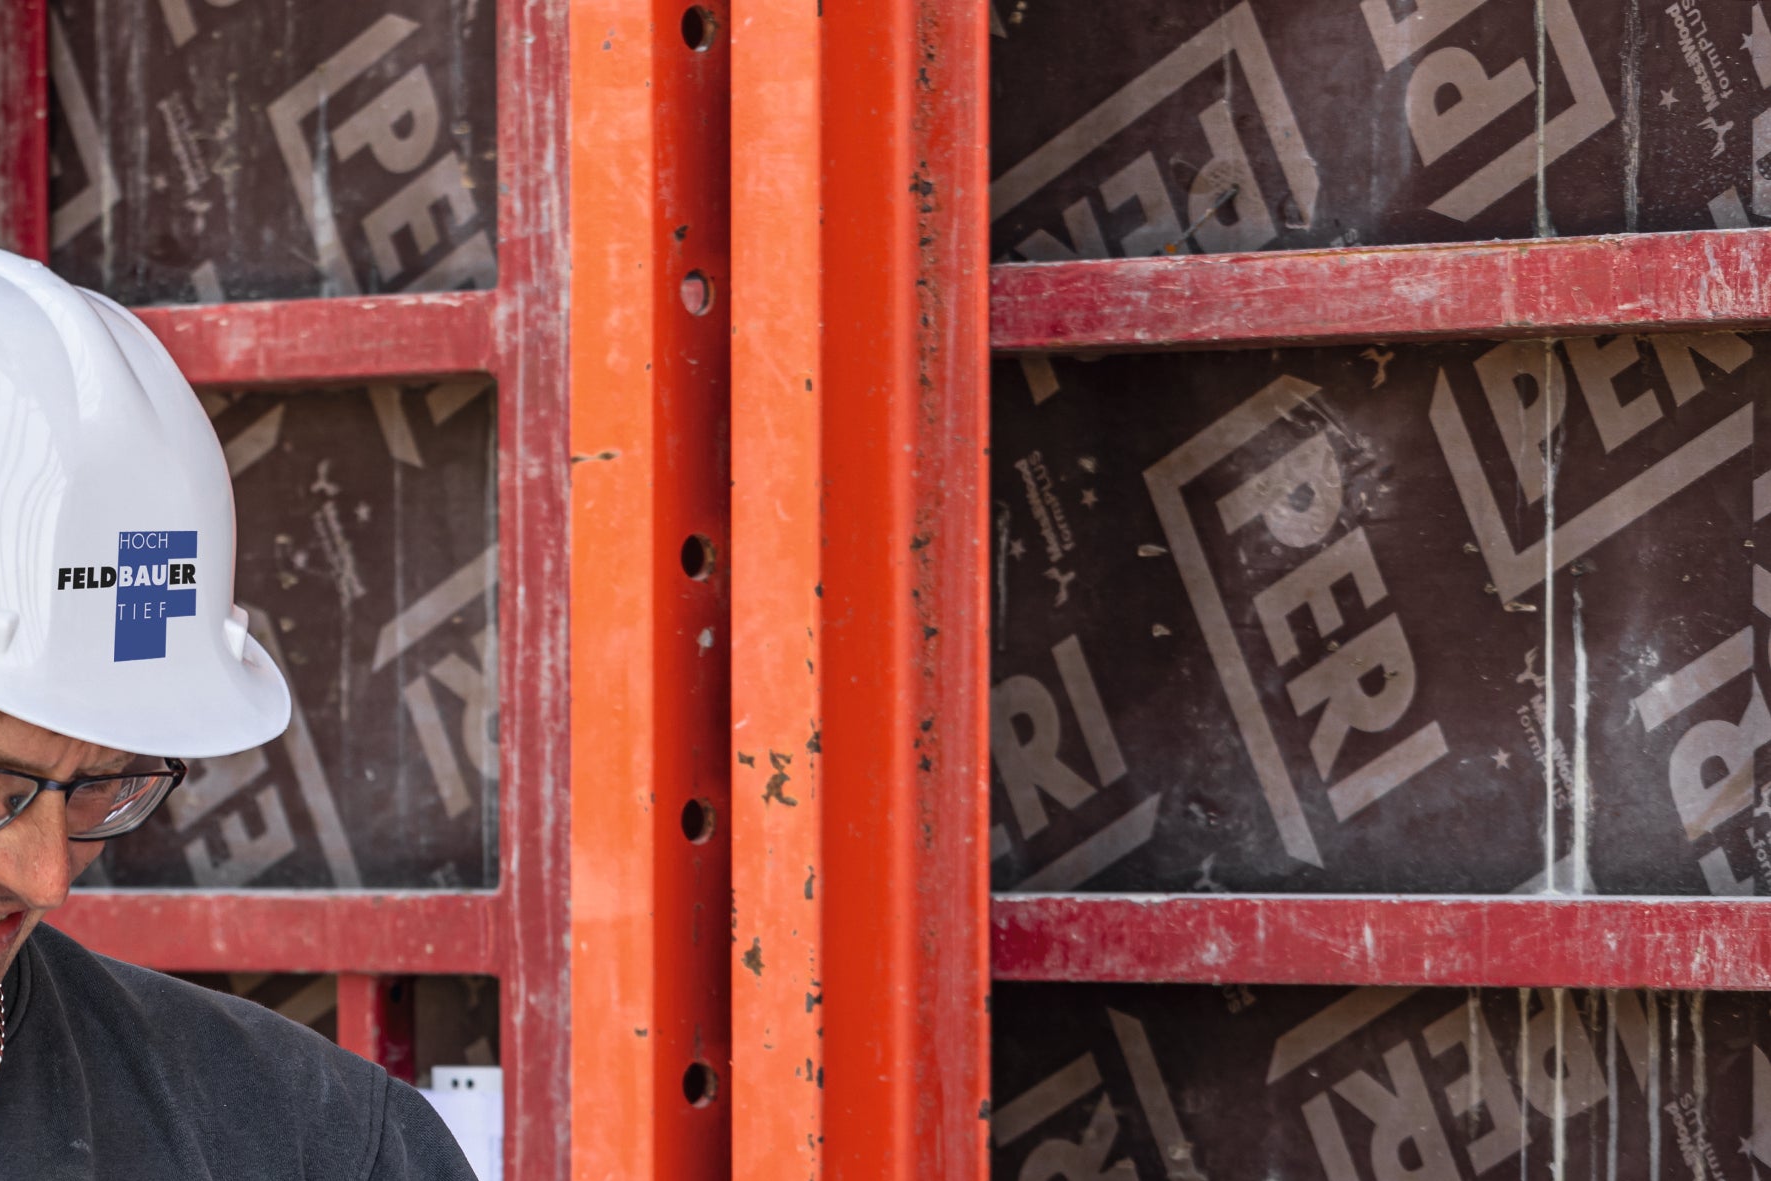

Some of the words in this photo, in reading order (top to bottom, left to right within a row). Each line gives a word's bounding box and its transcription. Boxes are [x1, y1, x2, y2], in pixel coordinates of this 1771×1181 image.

[119, 533, 169, 550] HOCH
[57, 563, 197, 591] FELDBAUER
[118, 601, 167, 621] TIEF
[1215, 428, 1449, 824] PERI
